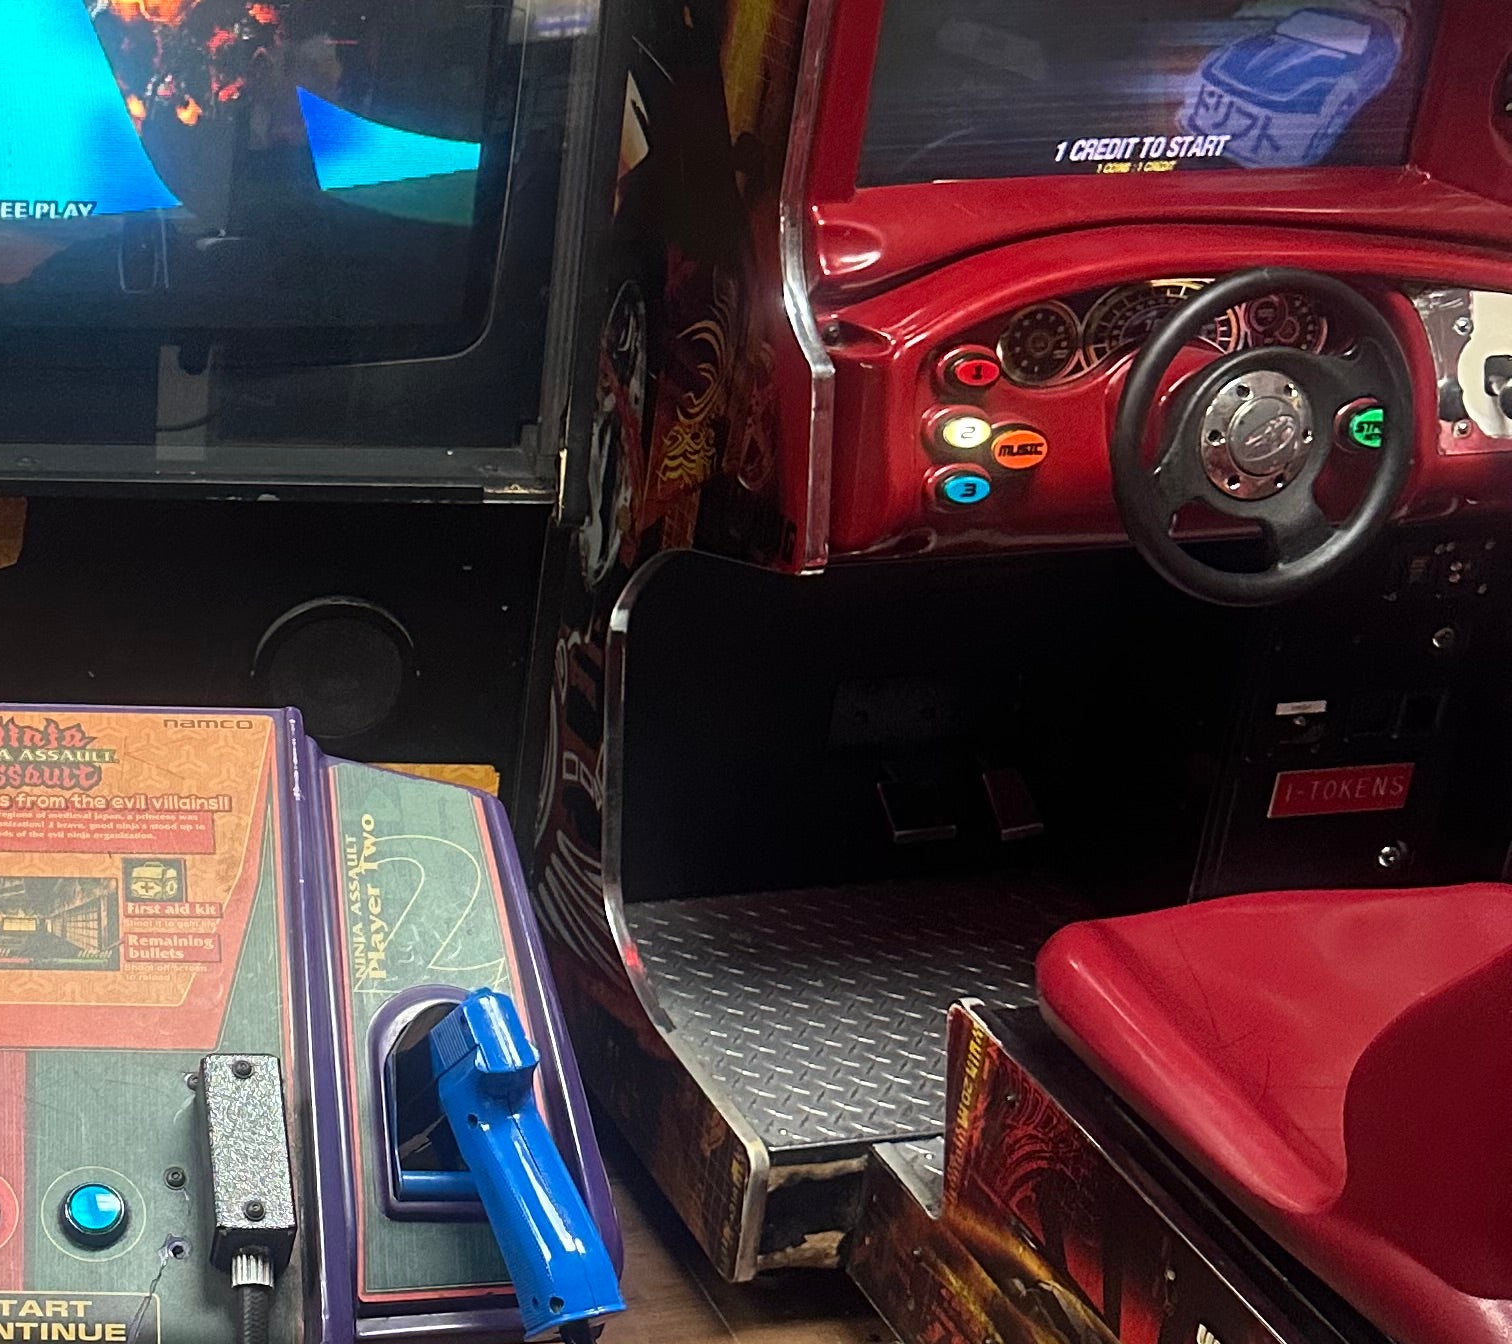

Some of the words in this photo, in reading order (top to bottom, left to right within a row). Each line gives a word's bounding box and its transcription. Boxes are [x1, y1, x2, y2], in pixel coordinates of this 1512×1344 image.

[1055, 141, 1068, 162] 1
[1069, 138, 1140, 161] CREDIT
[1139, 136, 1167, 159] TO
[1167, 135, 1231, 158] START
[34, 201, 94, 219] PLAY
[973, 365, 983, 380] 1
[960, 426, 976, 439] 2
[998, 443, 1044, 457] MUSIC
[960, 482, 977, 497] 3
[163, 719, 253, 730] namco
[20, 748, 111, 763] ASSAULT
[16, 792, 69, 808] from
[70, 794, 106, 808] the
[112, 794, 146, 809] evil
[361, 813, 379, 875] Two
[345, 834, 362, 916] ASSAULT
[127, 903, 161, 914] First
[165, 903, 190, 915] aid
[195, 903, 217, 915] kit
[367, 883, 389, 980] Player
[127, 935, 214, 949] Remaining
[129, 947, 185, 959] bullets
[352, 922, 366, 979] NINJA
